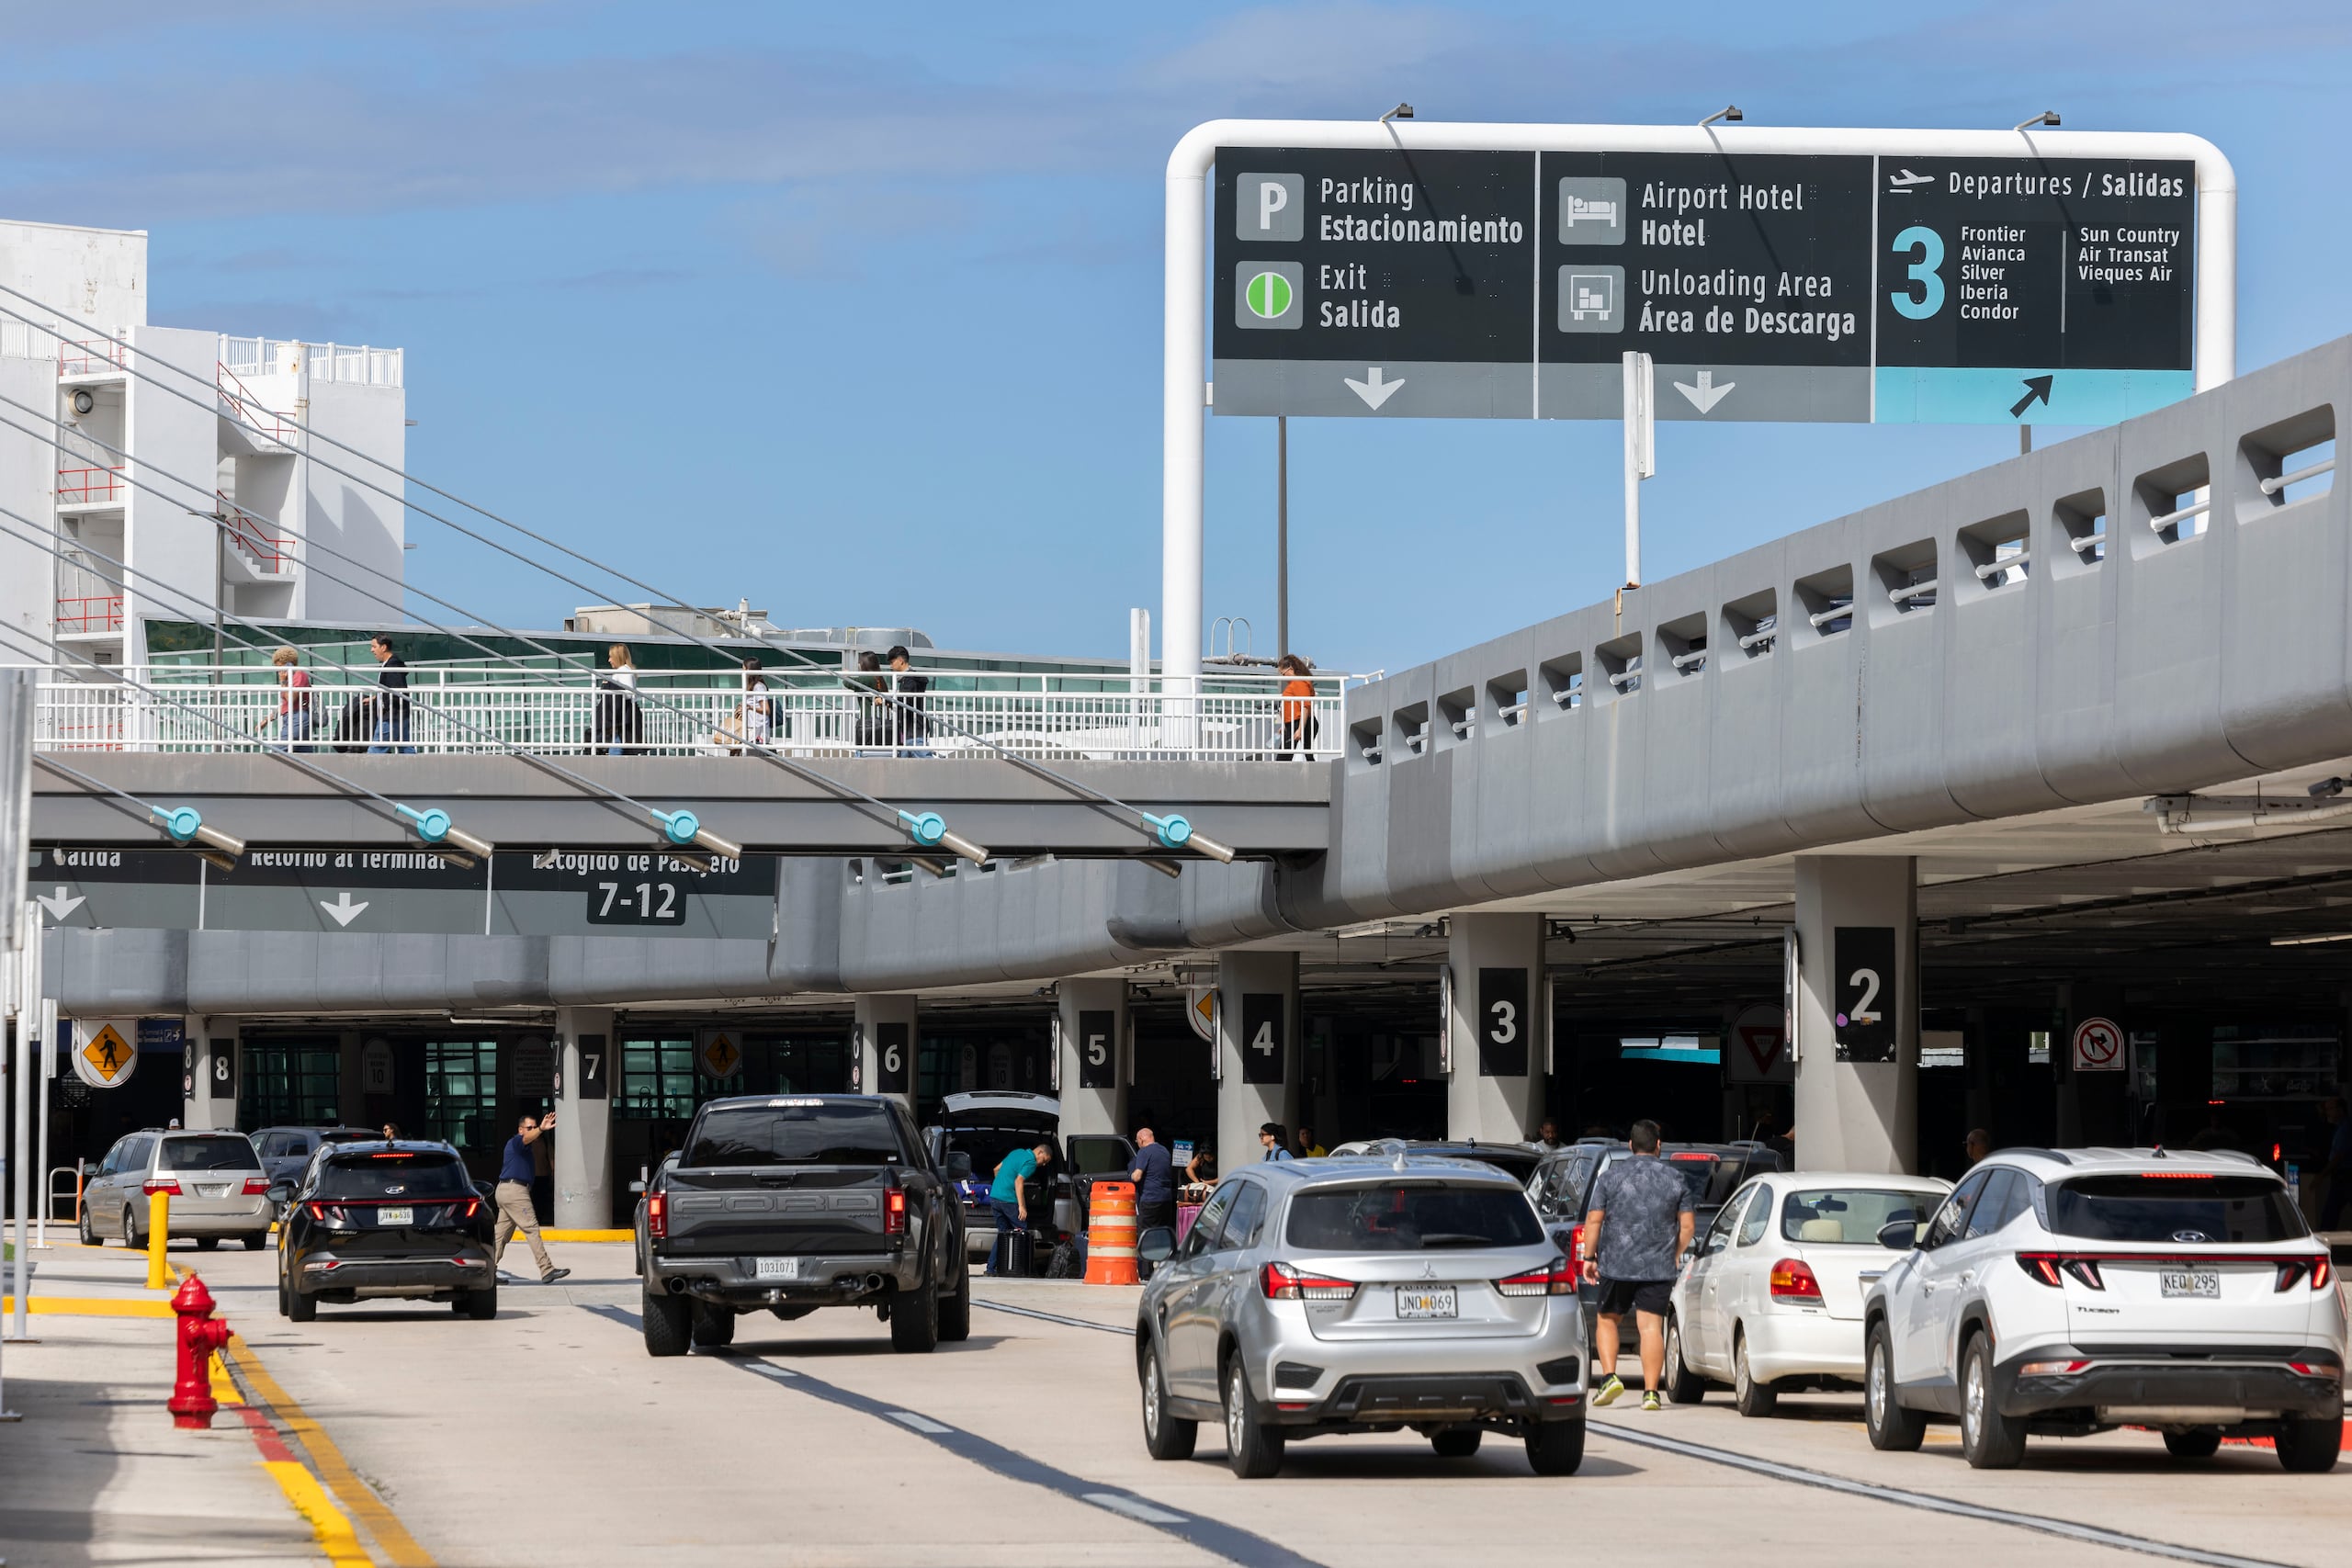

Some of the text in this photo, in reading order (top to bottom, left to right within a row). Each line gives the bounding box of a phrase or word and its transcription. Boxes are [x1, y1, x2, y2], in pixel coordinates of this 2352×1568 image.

[1320, 176, 1413, 211] Parking
[1949, 172, 2184, 200] Departures / Salidas
[1260, 182, 1288, 231] P
[1642, 183, 1803, 216] Airport Hotel
[1320, 215, 1523, 243] Estacionamiento
[1642, 219, 1705, 246] Hotel
[1962, 226, 2026, 243] Frontier
[2080, 227, 2180, 247] Sun Country
[1962, 245, 2025, 262] Avianca
[2079, 247, 2168, 263] Air Transat
[1320, 265, 1367, 290] Exit
[1891, 225, 1946, 321] 3
[1962, 265, 2005, 281] Silver
[2078, 265, 2173, 284] Vieques Air
[1641, 269, 1832, 305] Unloading Area
[1961, 284, 2008, 300] Iberia
[1319, 301, 1400, 328] Salida
[1638, 300, 1856, 342] Área de Descarga
[1961, 304, 2019, 320] Condor
[62, 852, 121, 867] alida
[627, 855, 650, 872] de
[658, 855, 740, 878] Pasero
[598, 882, 676, 919] 7-12
[1785, 942, 1792, 994] 2
[1441, 976, 1446, 1019] 3
[1849, 968, 1882, 1021] 2
[1490, 1000, 1516, 1043] 3
[853, 1031, 860, 1059] 6
[1088, 1034, 1106, 1066] 5
[1251, 1021, 1275, 1056] 4
[186, 1044, 191, 1069] 8
[216, 1056, 229, 1081] 8
[584, 1054, 600, 1080] 7
[884, 1044, 900, 1073] 6
[373, 1068, 384, 1084] 10
[672, 1194, 879, 1213] FORD
[760, 1262, 795, 1274] 1031071
[2194, 1274, 2217, 1291] 295
[1430, 1294, 1453, 1310] 069
